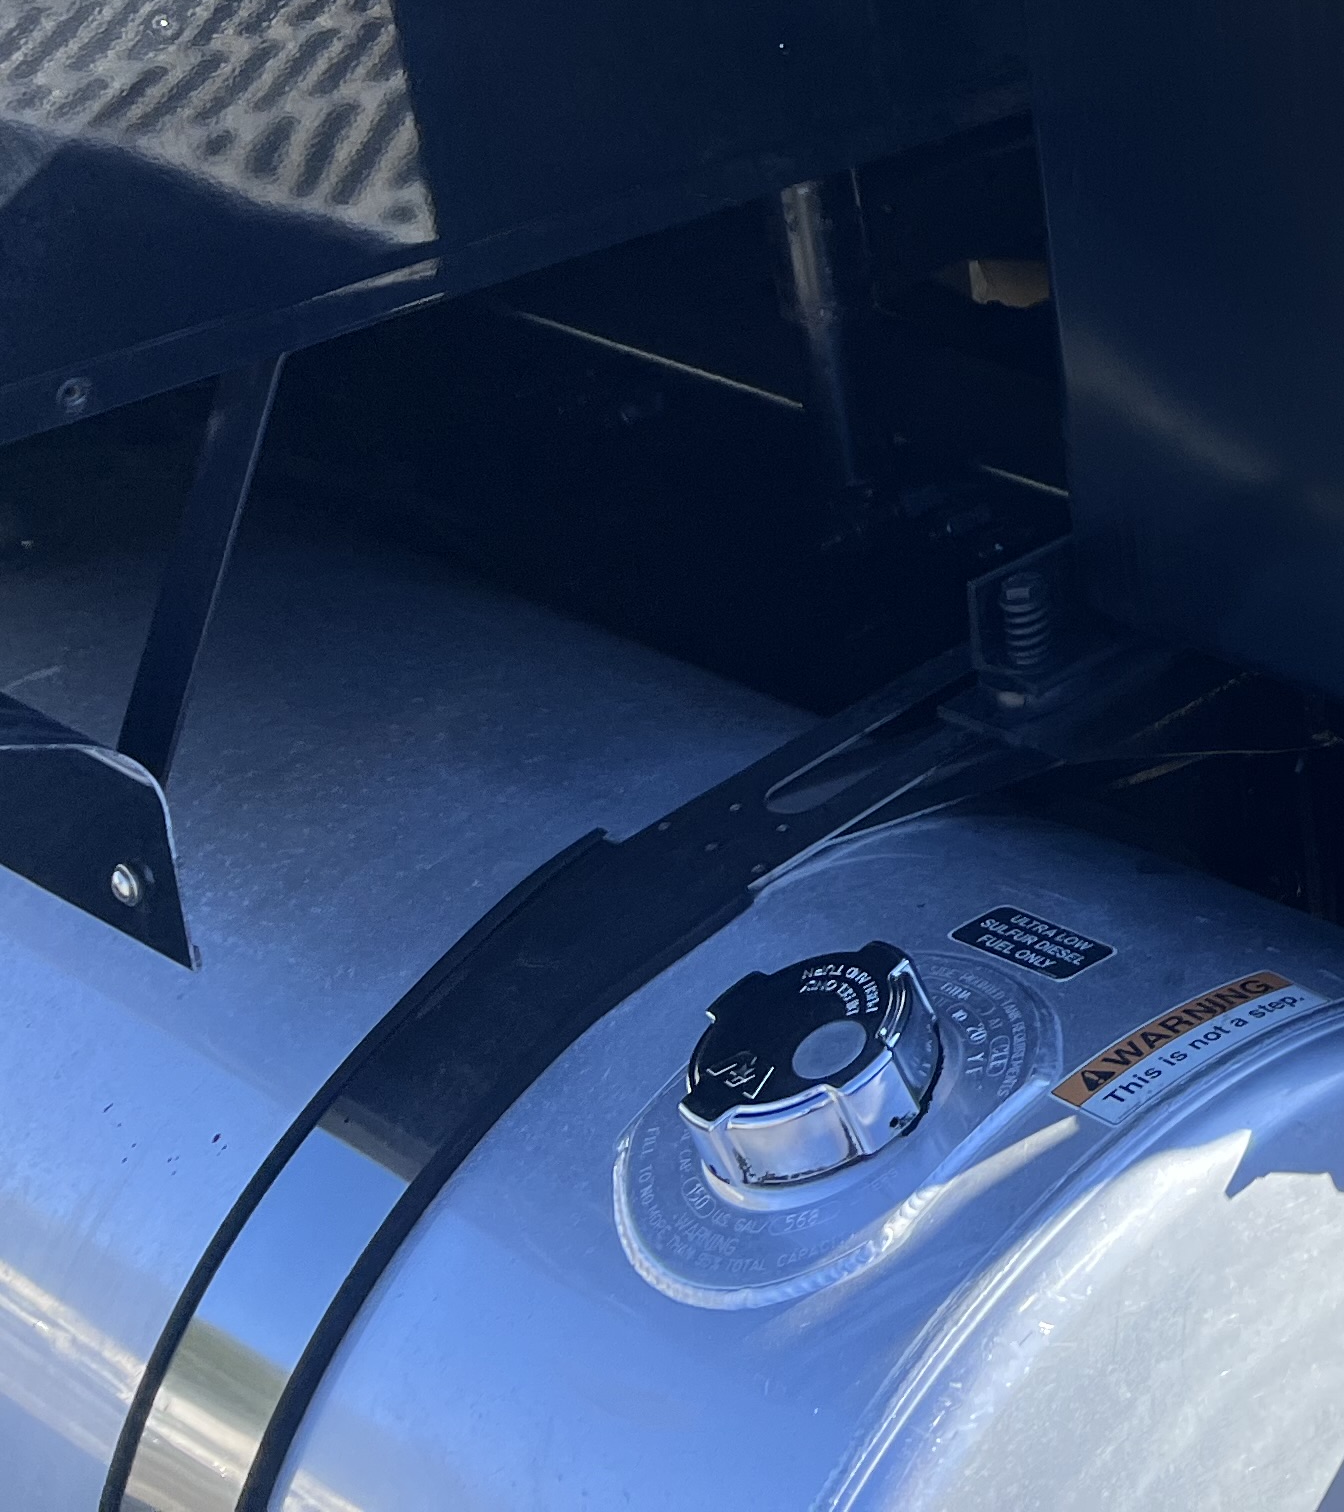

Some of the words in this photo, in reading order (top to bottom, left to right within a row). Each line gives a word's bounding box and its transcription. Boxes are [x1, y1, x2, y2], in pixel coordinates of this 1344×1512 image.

[980, 918, 1038, 946] SULFUR
[1033, 940, 1086, 966] DIESEL
[1010, 914, 1056, 938] ULTRA
[1056, 933, 1094, 951] LOW
[975, 934, 1017, 955] FUEL
[1014, 949, 1057, 968] ONLY
[1102, 979, 1274, 1067] WARNING
[1103, 1068, 1163, 1103] This
[1158, 1050, 1188, 1067] is
[1189, 1025, 1231, 1051] not
[1230, 1016, 1248, 1028] a
[1248, 995, 1305, 1020] step.
[641, 1125, 661, 1155] FILL
[638, 1164, 653, 1183] TO
[640, 1184, 656, 1206] NO
[685, 1183, 711, 1211] 150
[648, 1204, 672, 1236] MORE
[676, 1211, 740, 1255] WARNING
[727, 1258, 767, 1273] TOTAL
